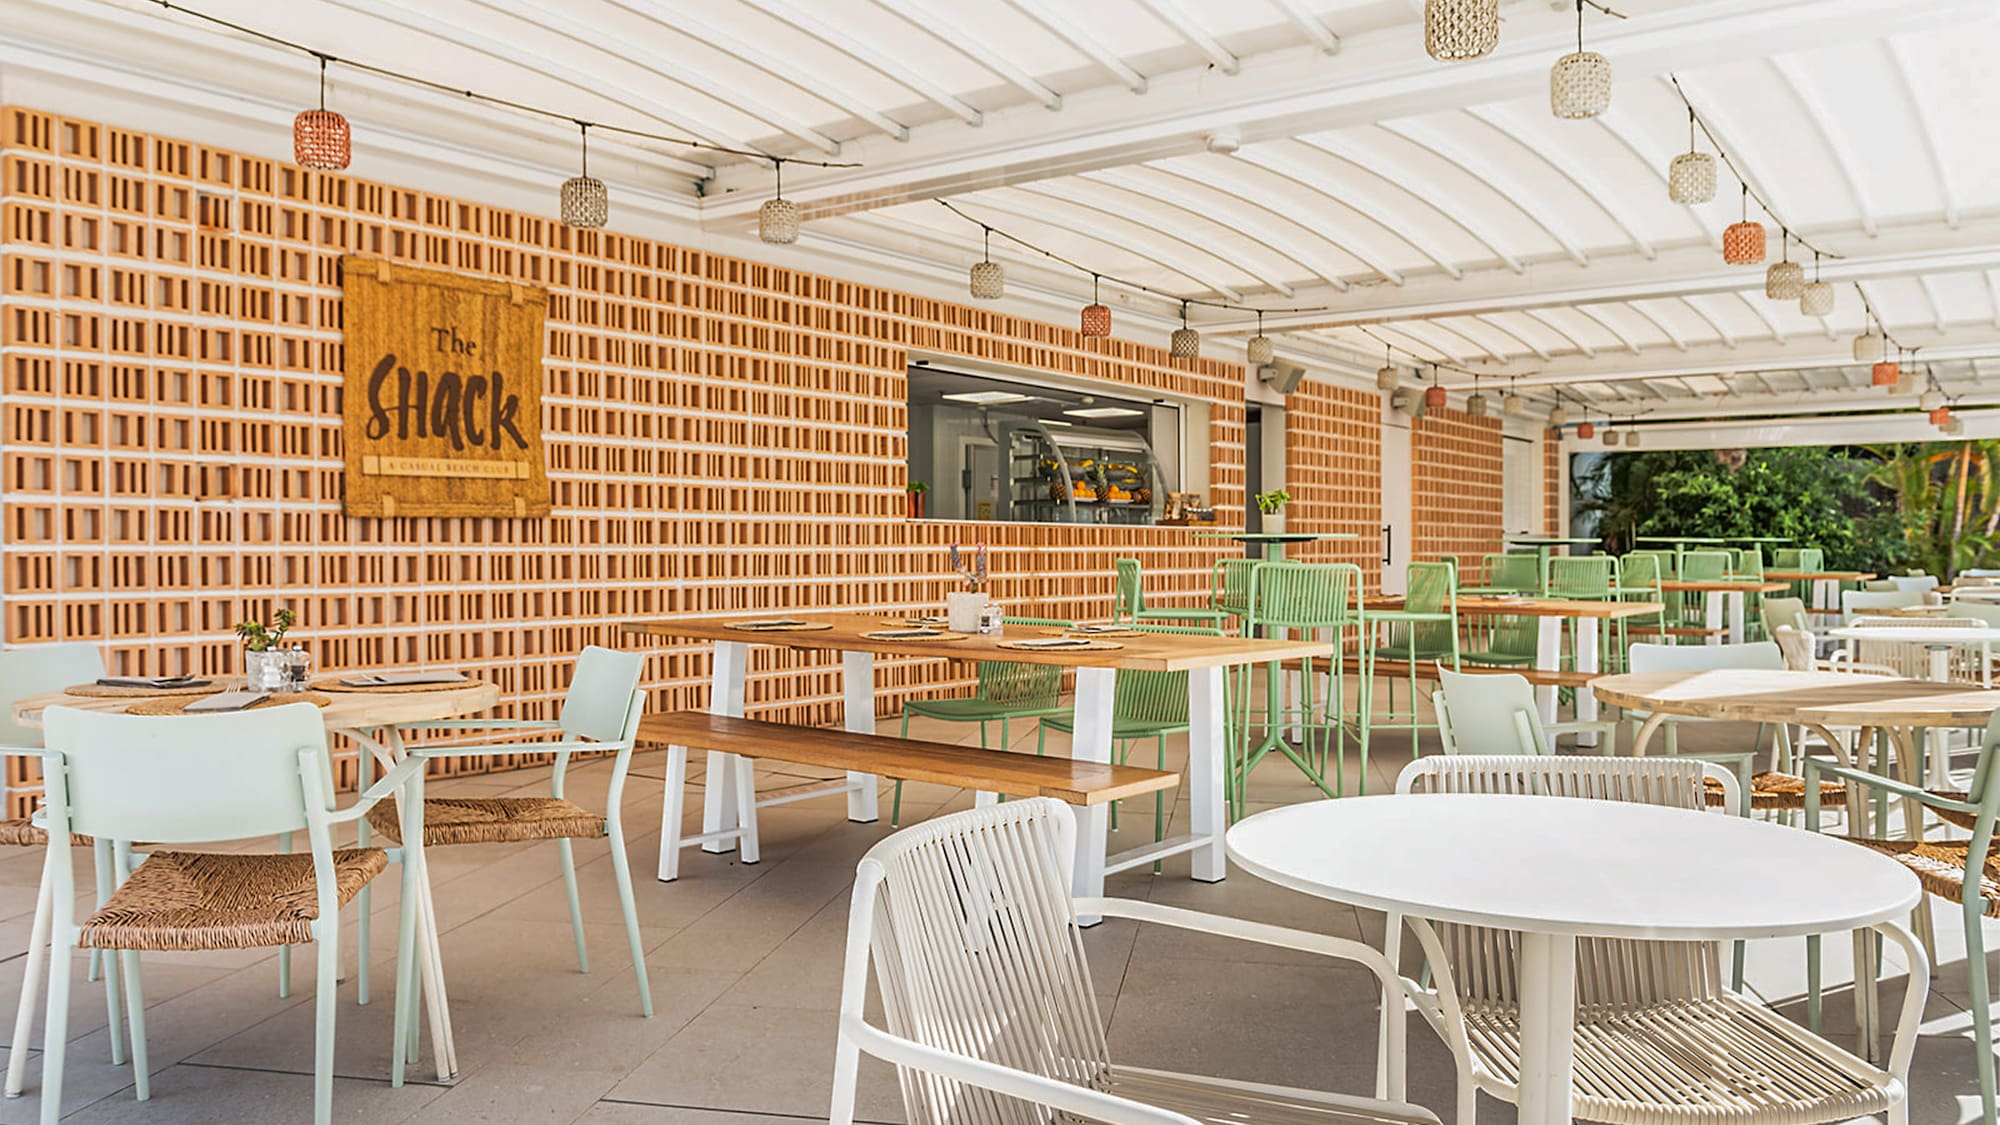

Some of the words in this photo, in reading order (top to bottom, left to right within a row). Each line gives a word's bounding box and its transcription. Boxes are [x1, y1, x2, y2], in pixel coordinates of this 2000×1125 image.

[431, 326, 477, 357] The
[401, 463, 441, 472] CASUAL
[446, 465, 479, 473] BEACH
[483, 466, 509, 474] CLUB
